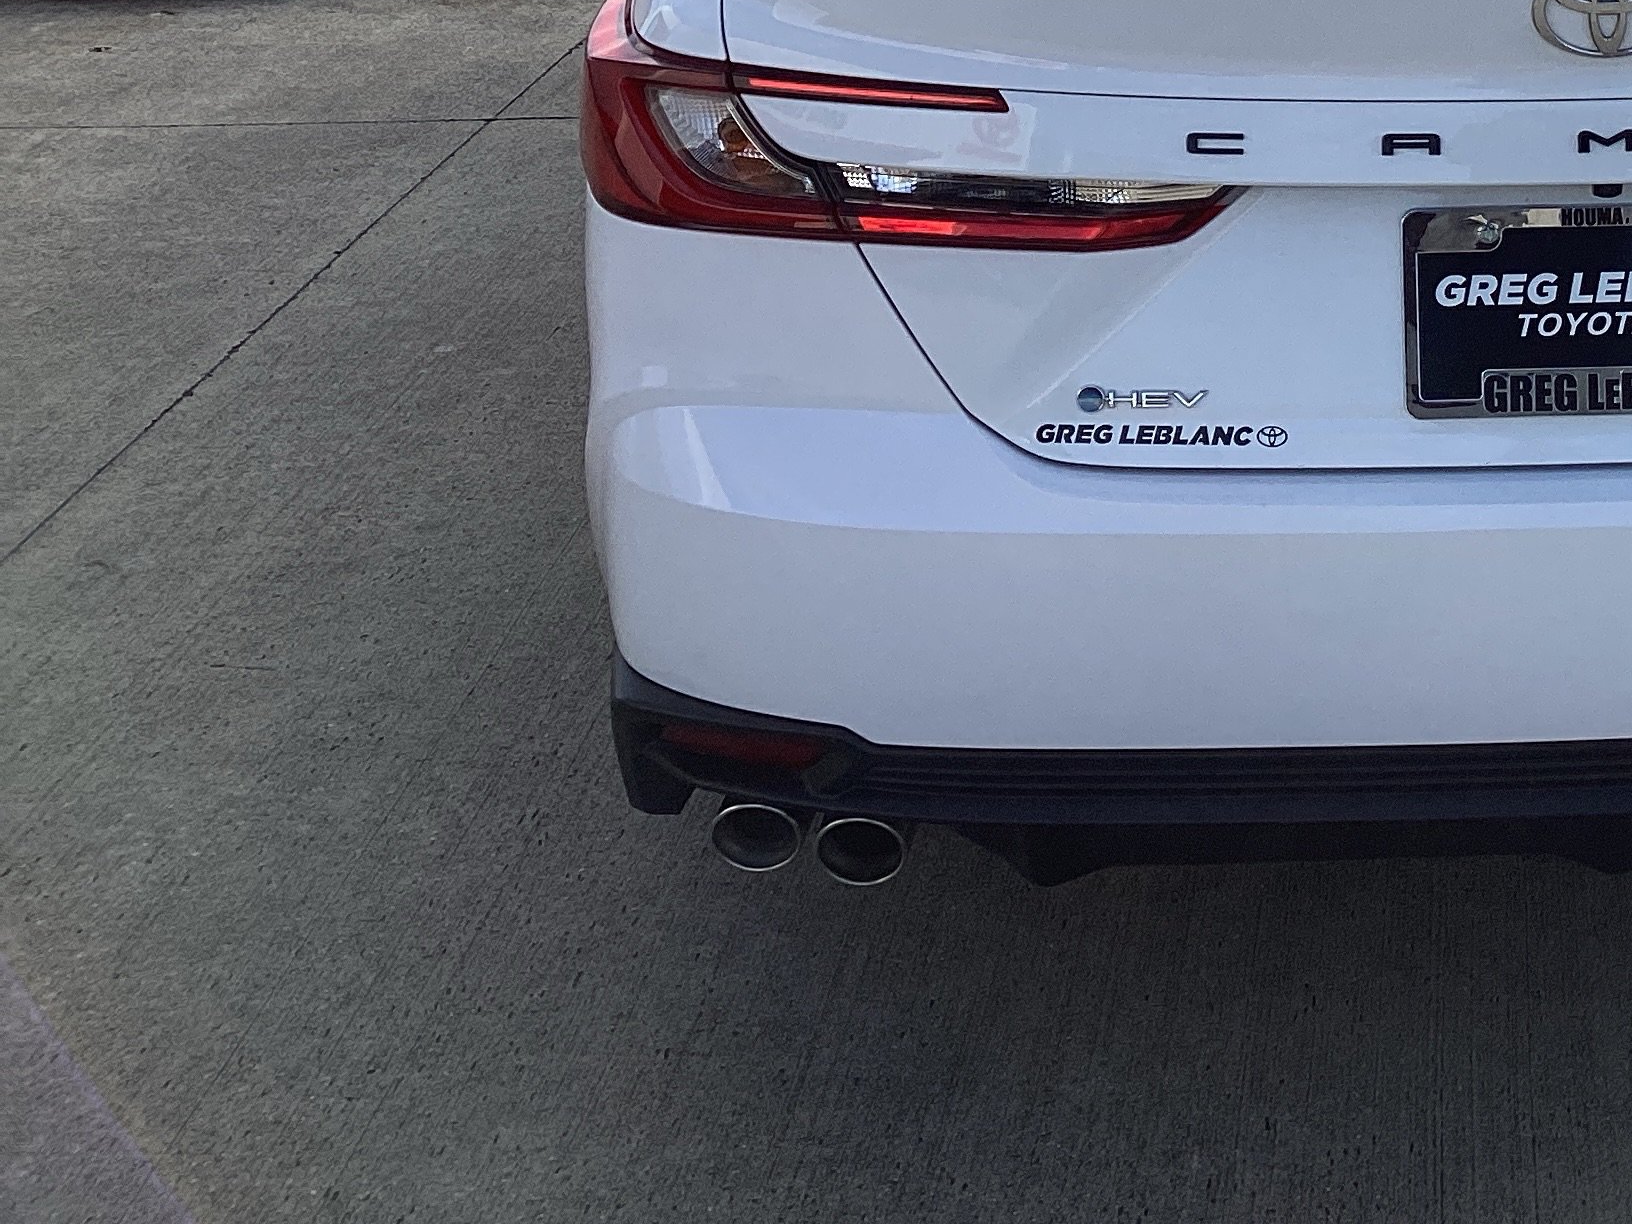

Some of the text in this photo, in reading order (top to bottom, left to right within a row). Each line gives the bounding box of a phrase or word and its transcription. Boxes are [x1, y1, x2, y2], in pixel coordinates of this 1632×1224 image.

[1434, 272, 1559, 307] GREG
[1106, 388, 1210, 409] HEV
[1483, 372, 1578, 413] GREG
[1034, 423, 1255, 447] GREG LEBLANC
